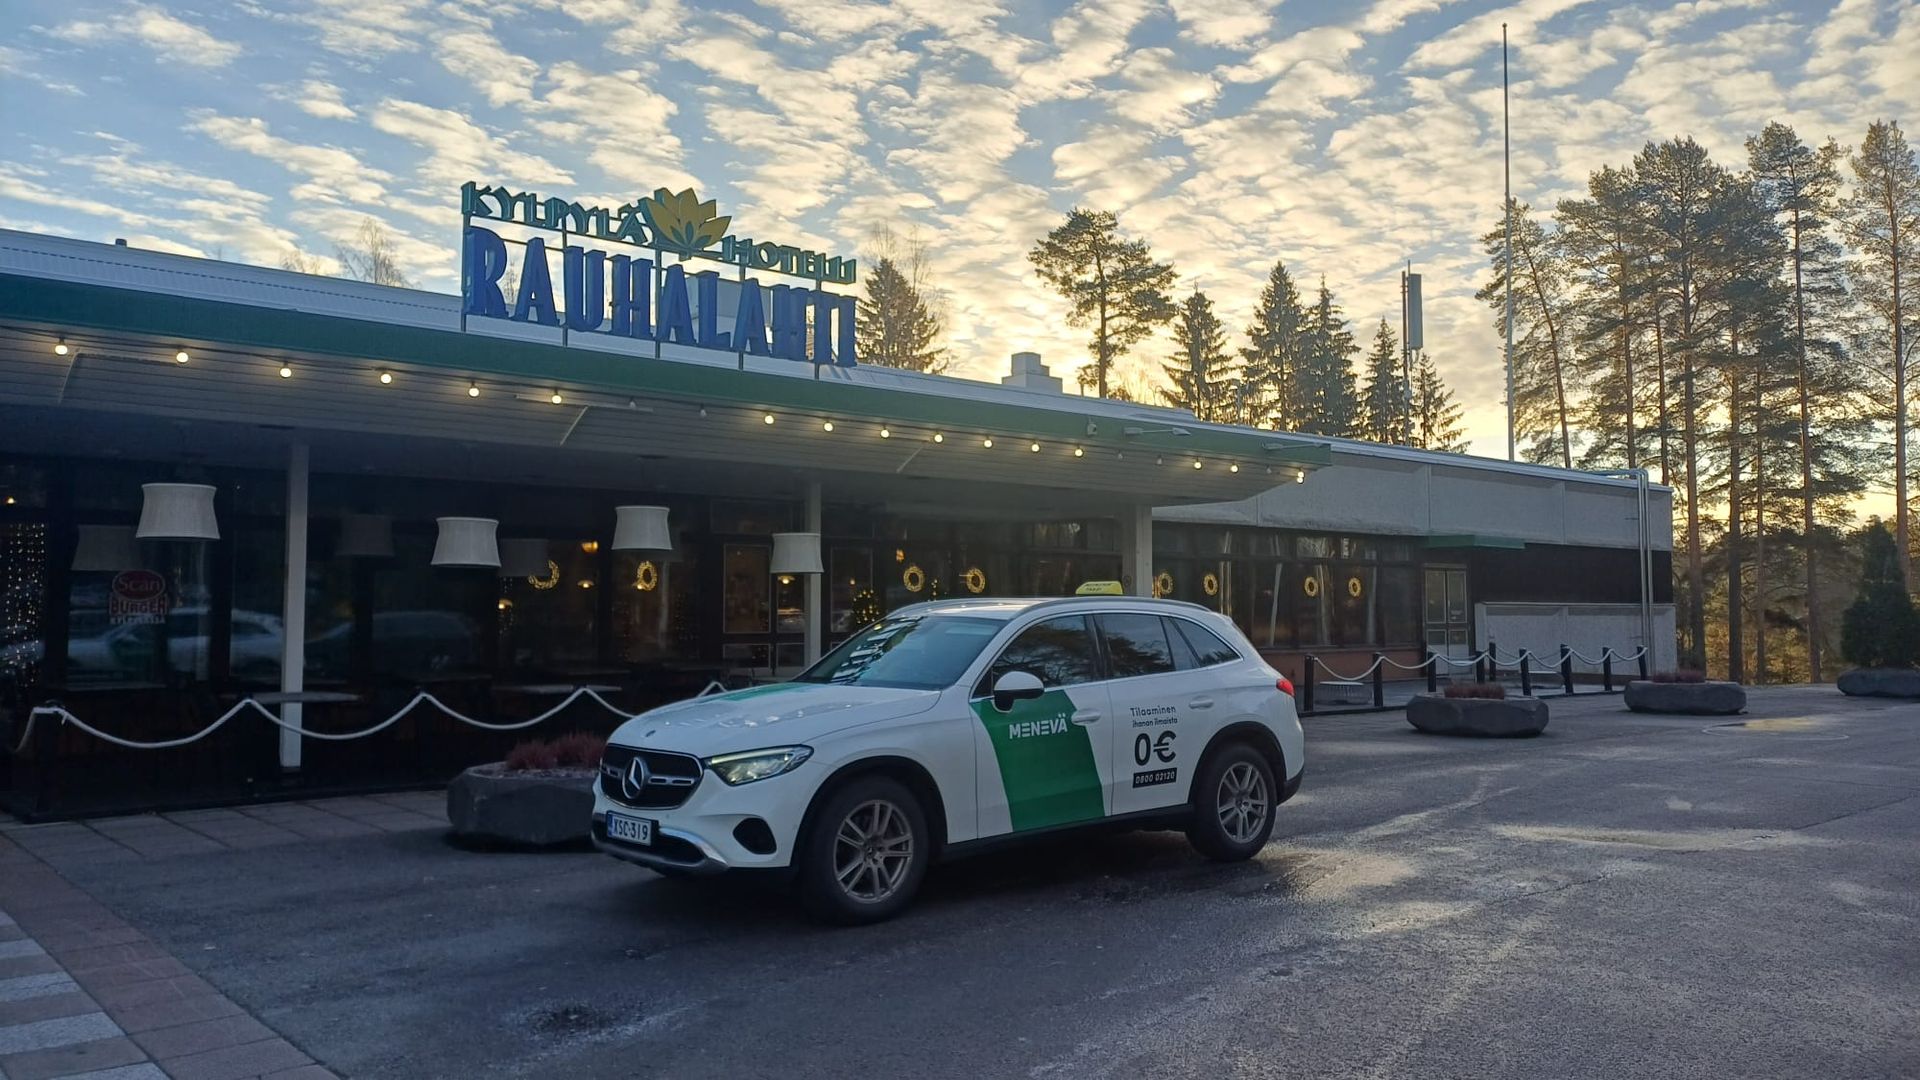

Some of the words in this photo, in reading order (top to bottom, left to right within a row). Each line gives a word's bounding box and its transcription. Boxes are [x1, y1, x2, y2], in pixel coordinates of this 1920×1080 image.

[721, 235, 857, 284] HOTELLI
[464, 225, 858, 367] RAUHALAHTI
[118, 576, 161, 592] Scan
[109, 596, 167, 615] BURGER
[1130, 705, 1177, 717] Tilaaminen
[1009, 713, 1068, 739] MENEVÄ
[1132, 719, 1154, 728] ihanan
[1154, 717, 1178, 727] ilmaista
[1134, 730, 1177, 766] 0€
[1135, 773, 1154, 784] 0800
[614, 818, 648, 840] XSC-319
